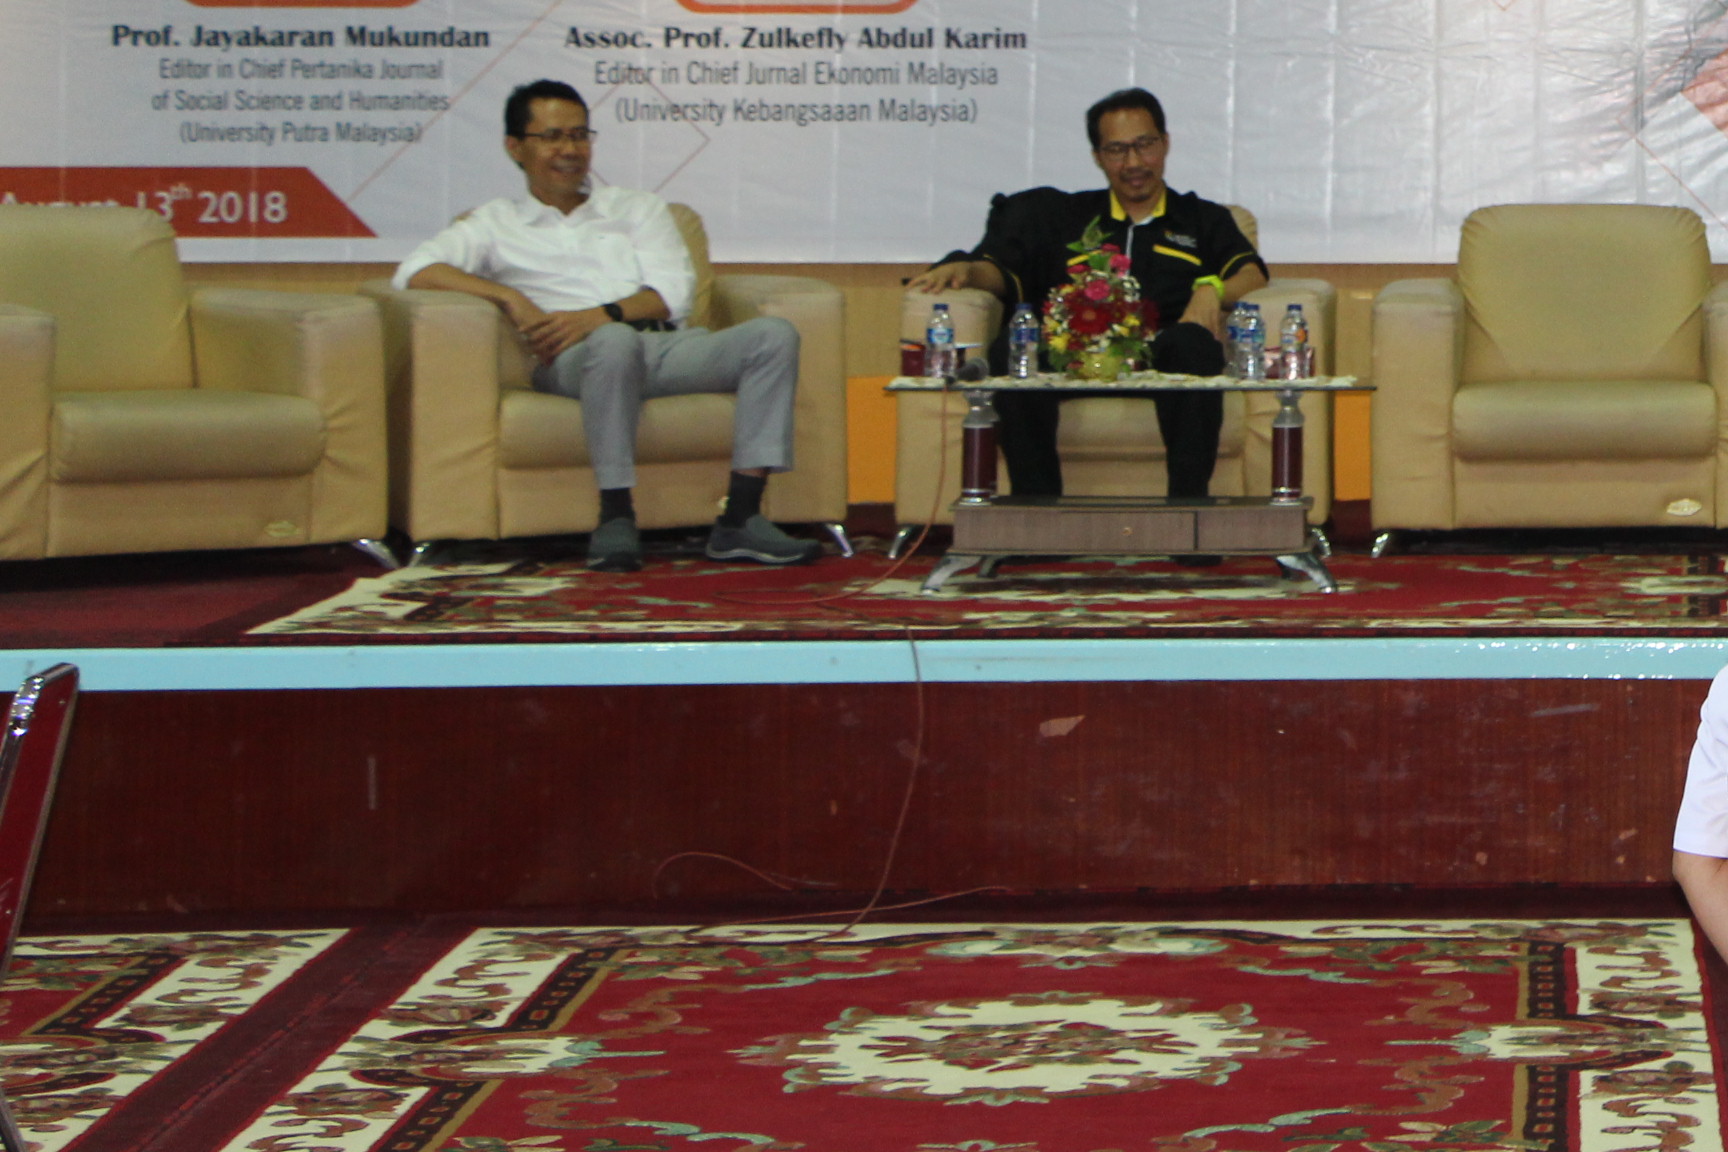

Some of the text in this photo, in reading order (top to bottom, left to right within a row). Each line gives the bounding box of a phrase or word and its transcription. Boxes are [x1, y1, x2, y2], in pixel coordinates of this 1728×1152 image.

[112, 24, 490, 53] Prof. Jayakaran Mukundan
[564, 26, 1027, 54] Assoc. Prof. Zulkefly Abdul Karim
[158, 57, 445, 80] Editor in Chief Pertanika Journal
[594, 60, 998, 91] Editor in Chief Jurnal Ekonomi Malaysia
[151, 88, 450, 111] of Social Science and Humanities
[614, 98, 727, 127] (University
[877, 98, 979, 127] Malaysia)
[179, 120, 424, 147] (University Putra Malaysia)
[198, 190, 288, 223] 2018
